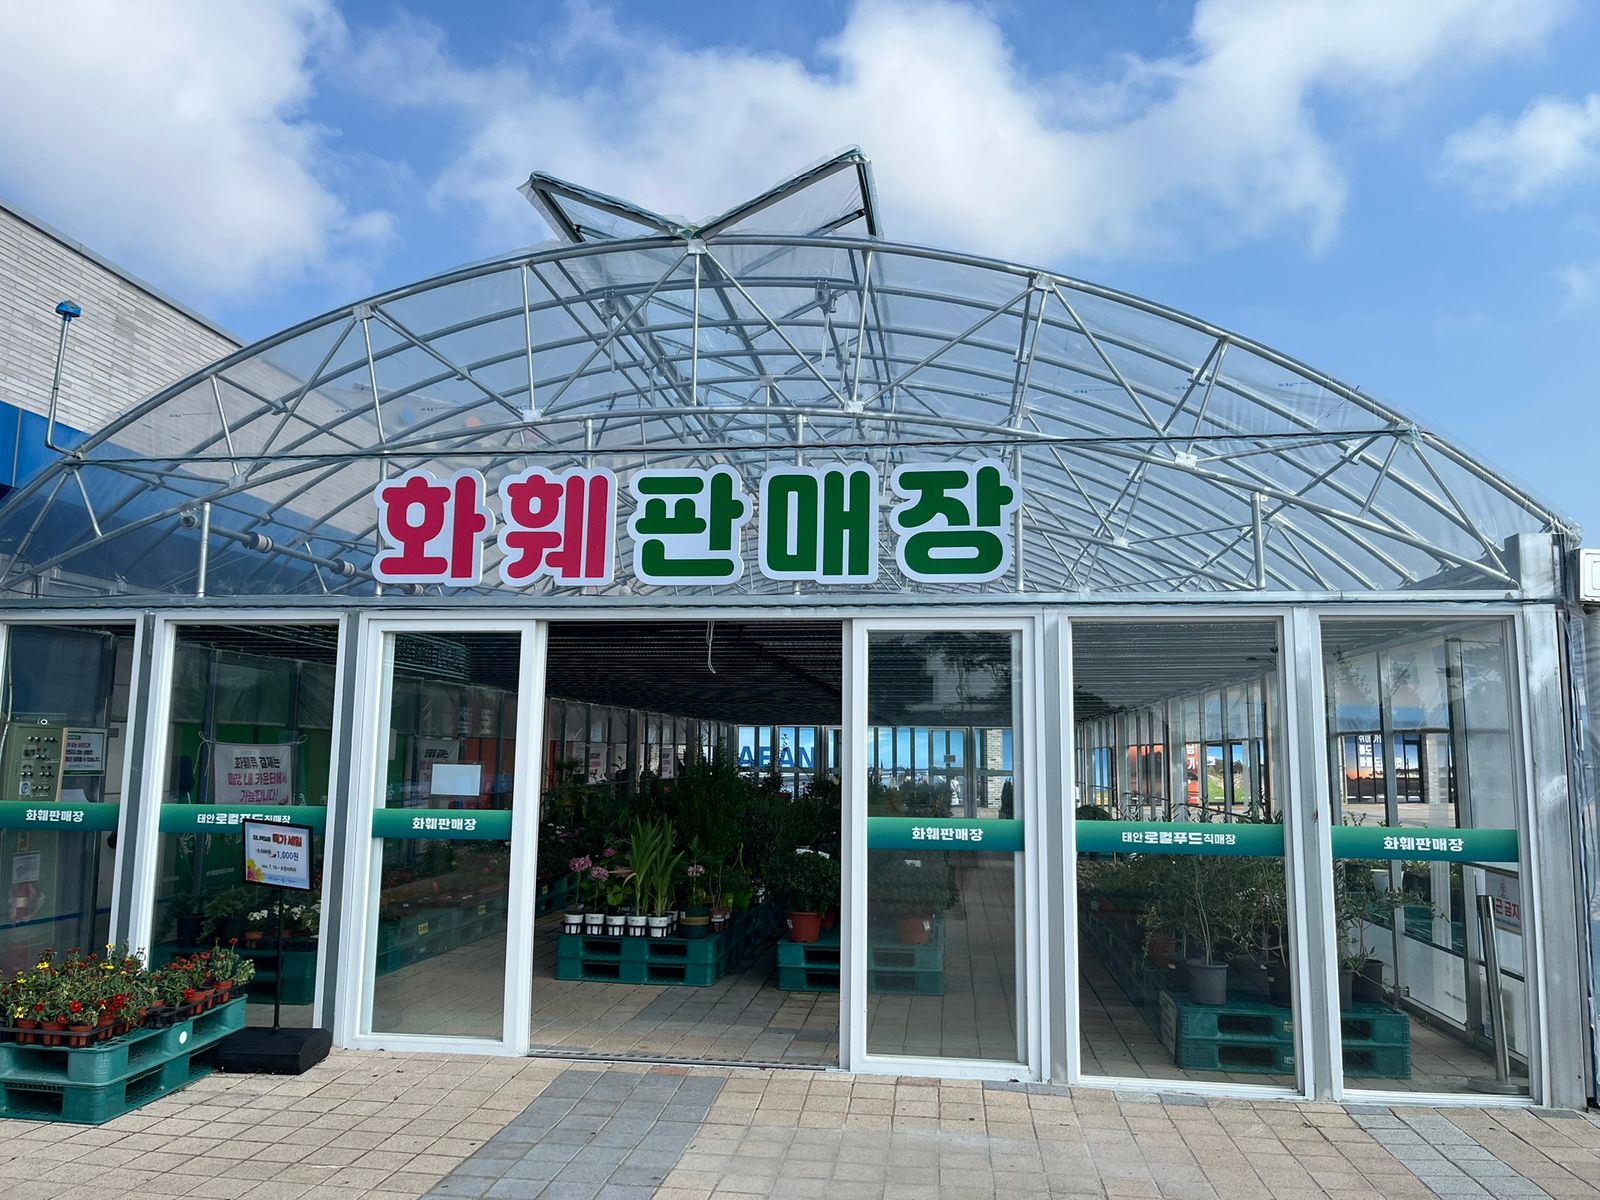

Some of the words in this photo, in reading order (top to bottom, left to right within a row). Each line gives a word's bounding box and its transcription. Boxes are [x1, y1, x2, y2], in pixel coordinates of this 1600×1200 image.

[378, 465, 1016, 580] 화훼판매장
[234, 756, 258, 769] 화훼류
[259, 756, 280, 769] 결제는
[228, 773, 242, 786] 매장
[244, 772, 253, 785] 내
[255, 772, 287, 785] 카운터에서
[240, 789, 279, 803] 가능합니다!
[26, 809, 84, 823] 화훼판매장
[412, 817, 477, 831] 화훼판매장
[911, 827, 983, 842] 화훼판매장
[1383, 836, 1464, 852] 화훼판매장
[277, 850, 298, 861] 1,000원
